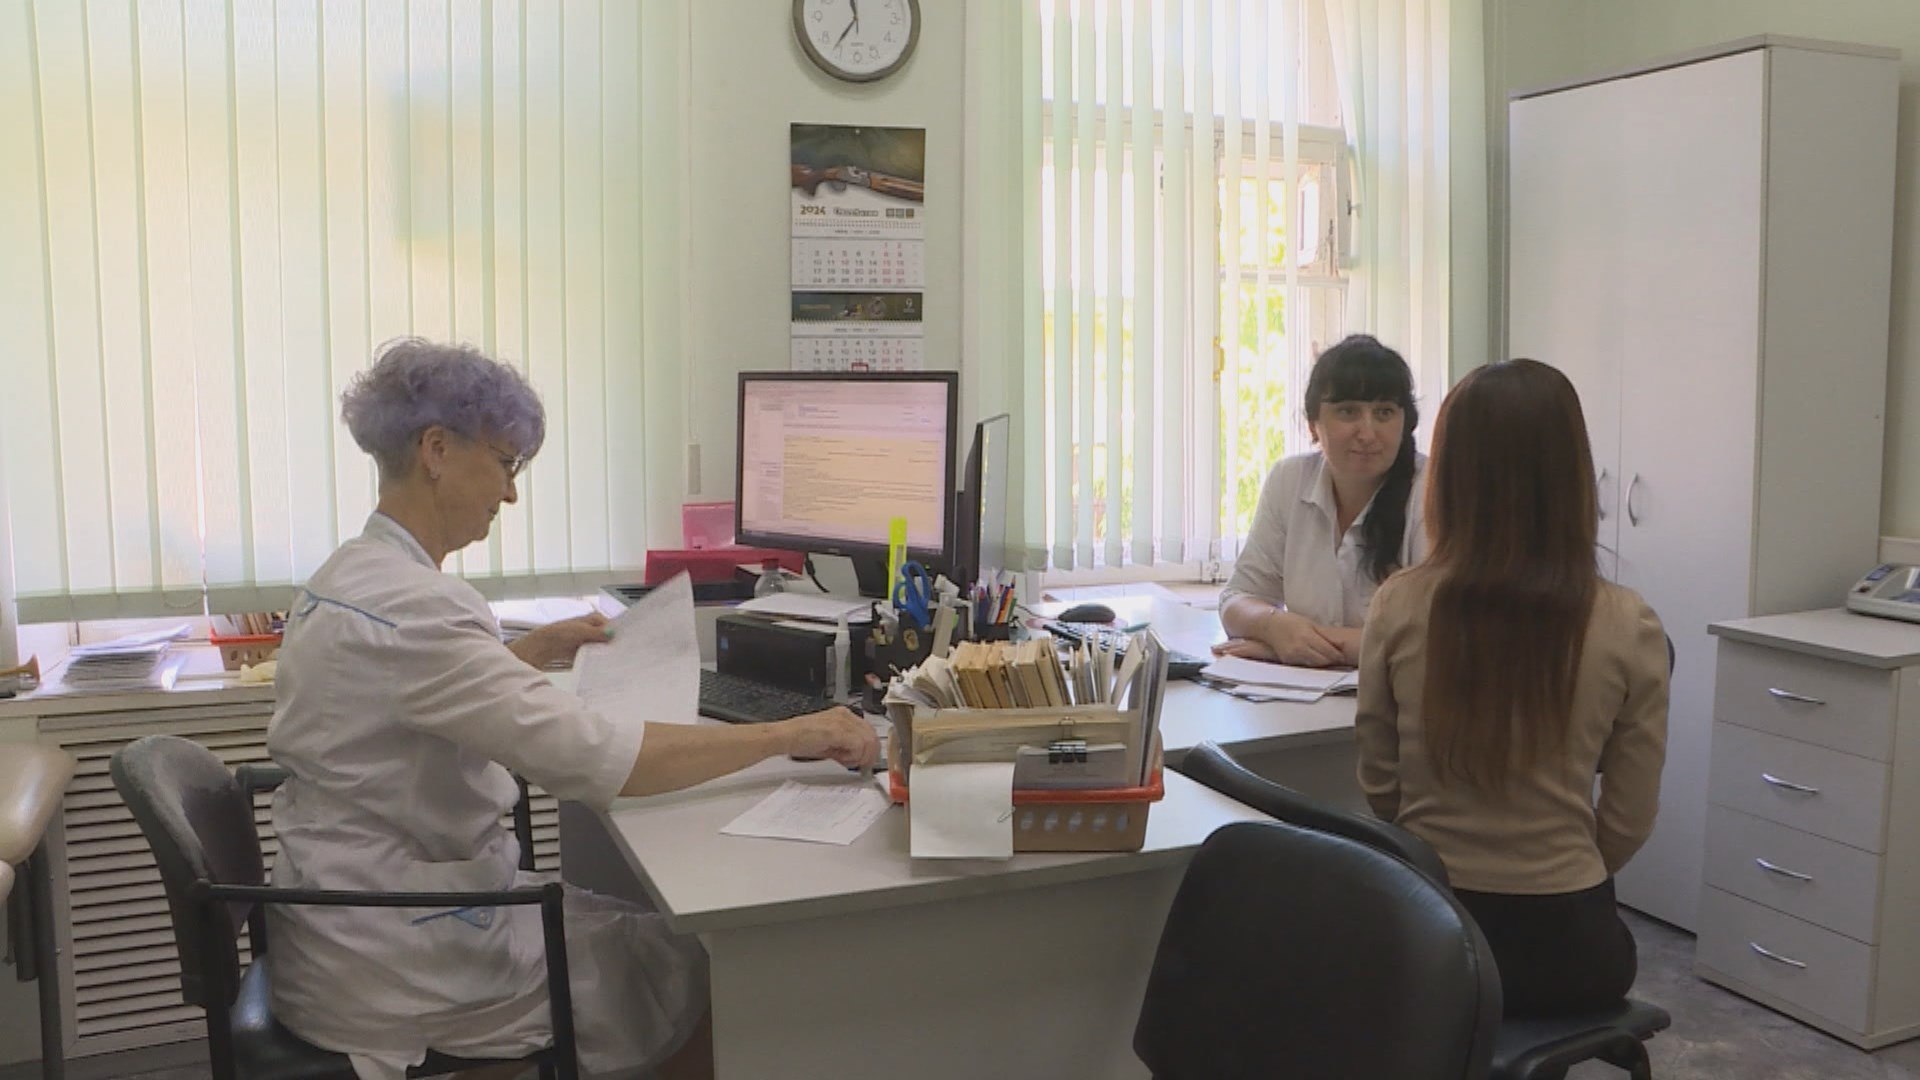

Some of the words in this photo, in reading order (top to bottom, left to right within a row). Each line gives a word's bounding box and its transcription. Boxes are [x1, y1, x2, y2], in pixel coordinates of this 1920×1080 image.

[814, 10, 823, 23] 9
[890, 12, 898, 25] 3
[821, 31, 830, 44] 8
[883, 30, 891, 42] 4
[800, 205, 826, 215] 2024
